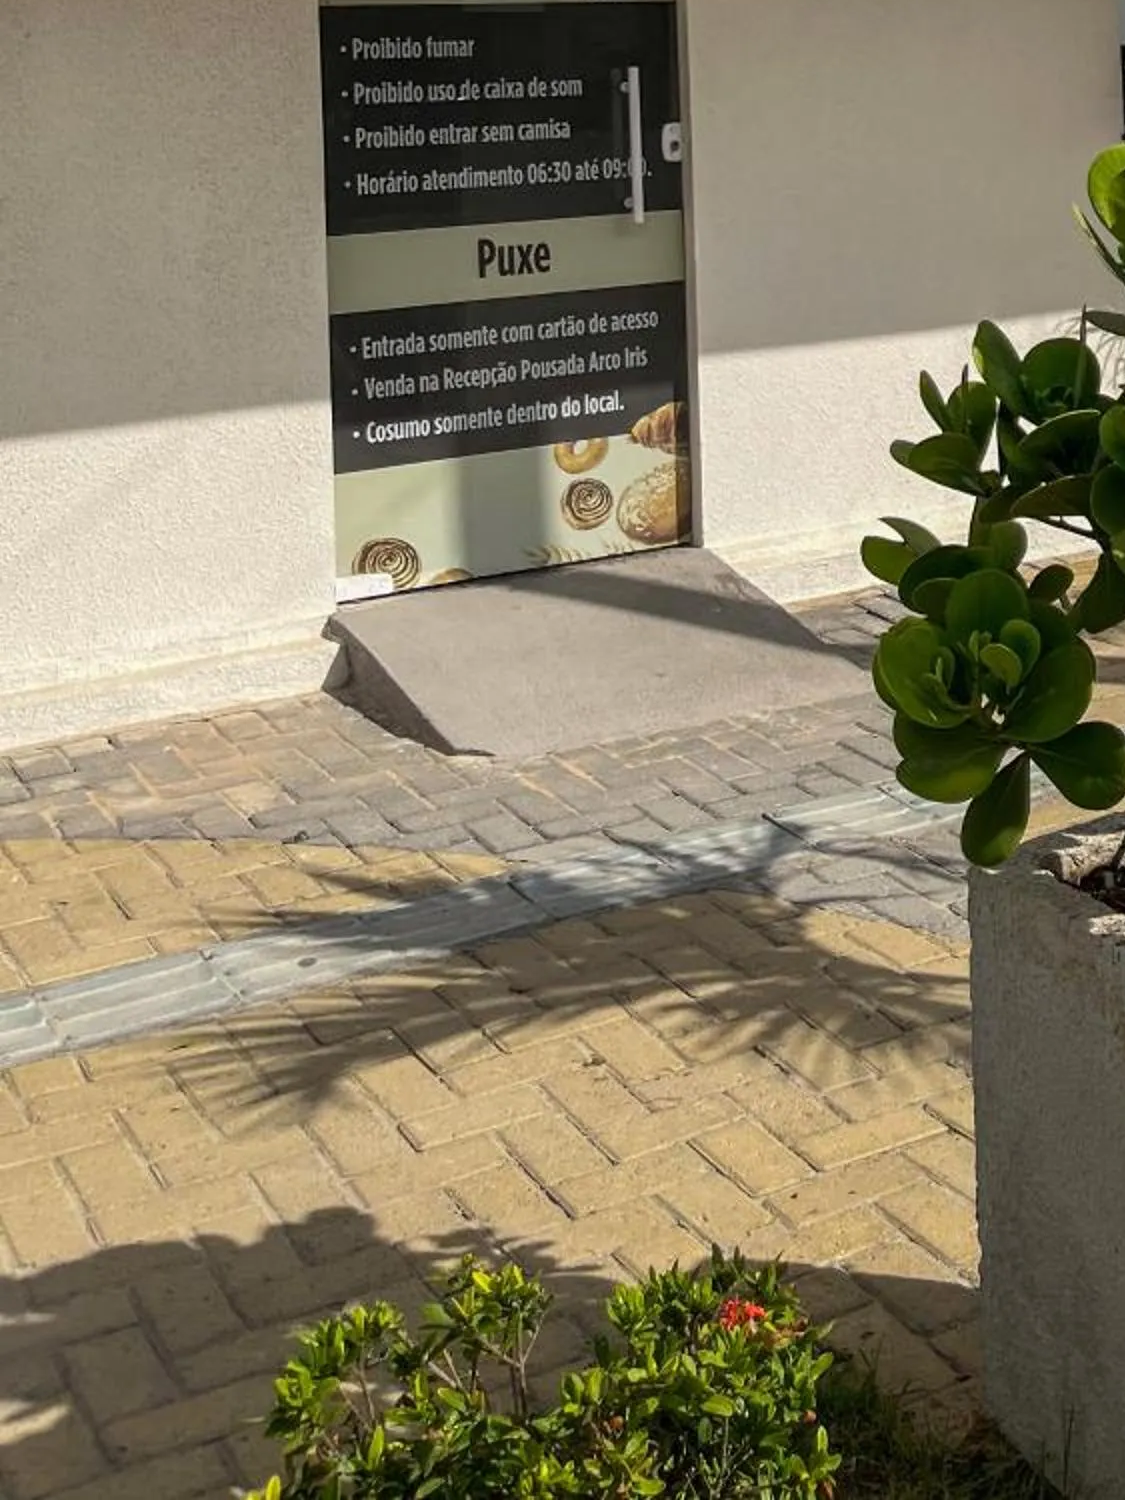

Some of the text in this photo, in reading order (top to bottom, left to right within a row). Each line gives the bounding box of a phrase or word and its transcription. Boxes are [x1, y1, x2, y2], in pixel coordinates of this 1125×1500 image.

[352, 36, 475, 60] Proibido fumar
[354, 76, 583, 105] Proibido uso de caixa de som
[355, 118, 571, 149] Proibido entrar sem camisa
[357, 168, 419, 195] Horário
[423, 163, 523, 190] atendimento
[527, 161, 571, 185] 06:30
[575, 158, 599, 181] até
[477, 238, 551, 278] Puxe
[362, 310, 659, 360] Entrada somente com cartão de acesso
[365, 346, 648, 400] Venda na Recepção Pousada Arco Iris
[367, 390, 625, 444] Cosumo somente dentro do local.
